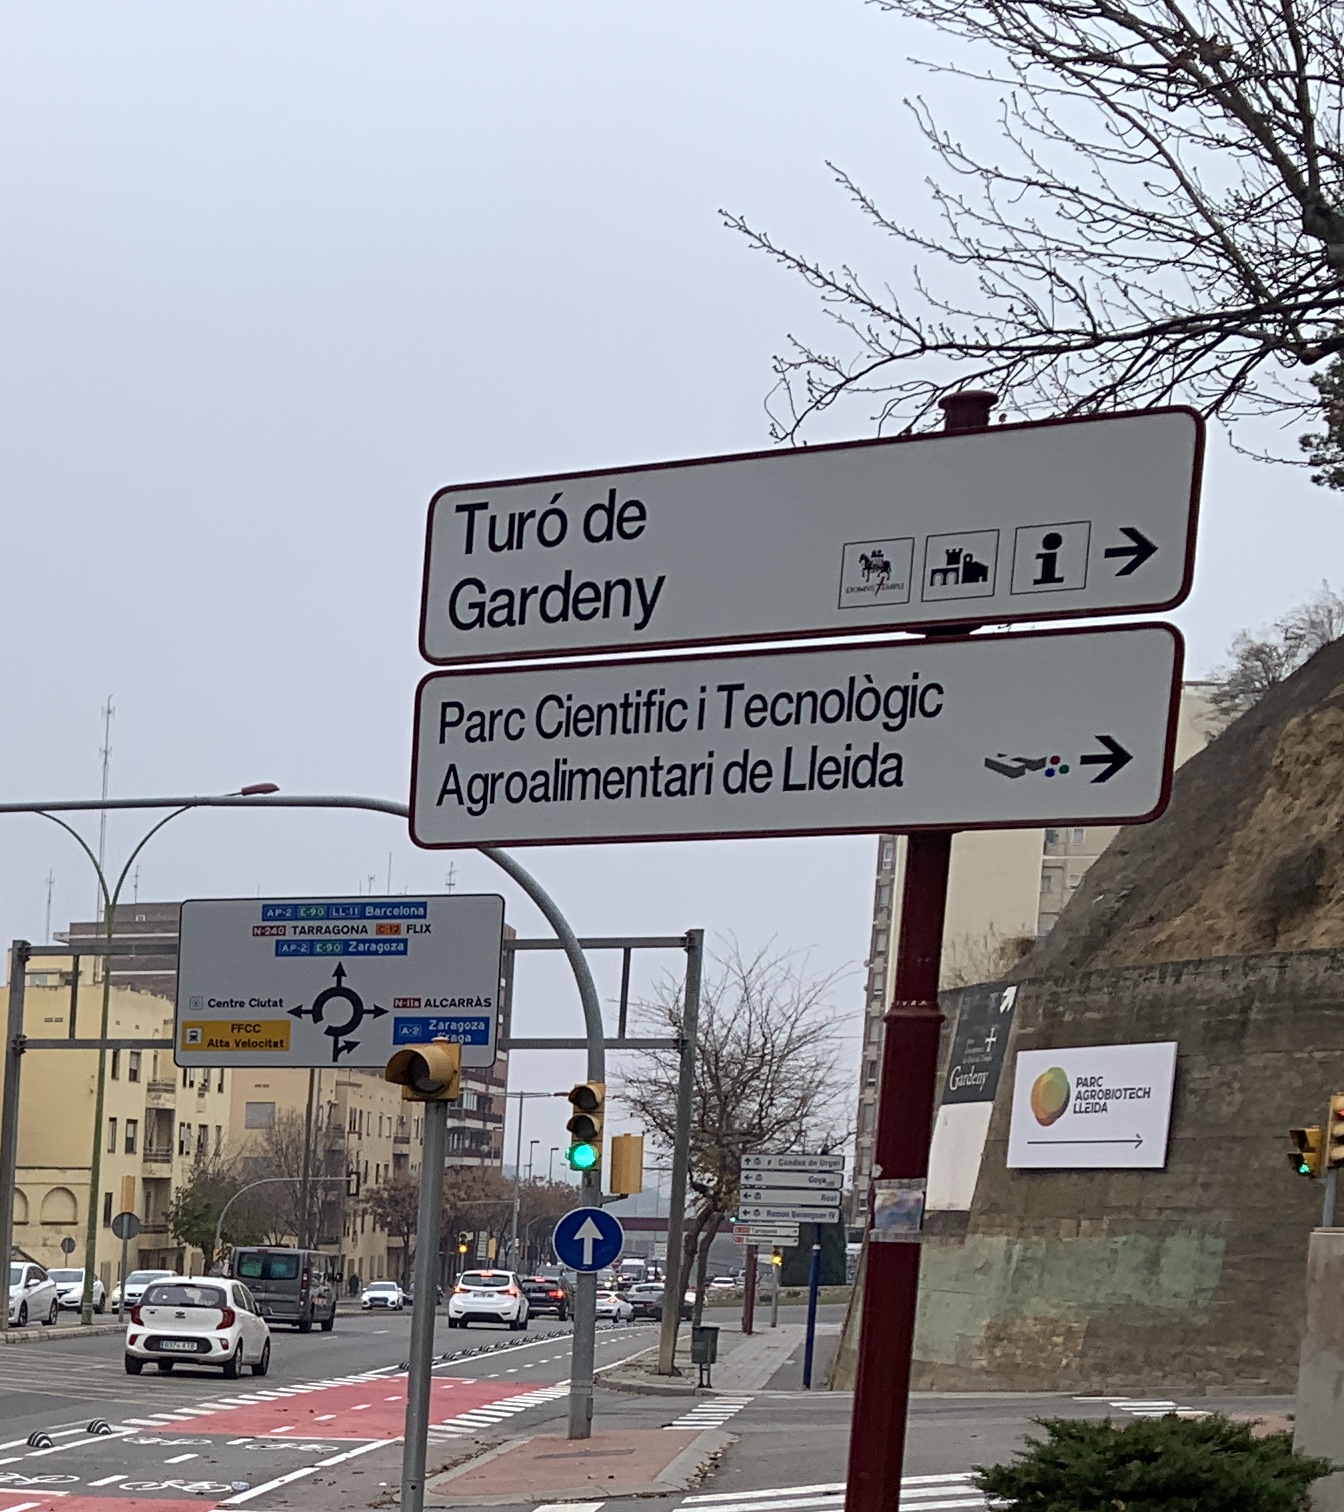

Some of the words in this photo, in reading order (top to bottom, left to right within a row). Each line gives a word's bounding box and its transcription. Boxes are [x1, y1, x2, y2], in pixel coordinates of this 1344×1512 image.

[455, 492, 568, 555] Turó
[583, 488, 647, 544] de
[448, 569, 666, 631] Gardeny
[439, 701, 526, 744] Parc
[697, 685, 707, 731] i
[716, 671, 945, 733] Tecnològic
[436, 750, 714, 817] Agroalimentari
[723, 748, 773, 795] de
[782, 741, 904, 792] Lleida
[266, 908, 292, 917] AP-2
[299, 906, 325, 917] E-90
[365, 905, 424, 917] Barcelona
[253, 926, 285, 935] N-240
[291, 925, 368, 935] TARRAGONA
[406, 923, 432, 934] FLIX
[281, 943, 308, 953] AP-2
[315, 943, 341, 953] E-90
[348, 941, 404, 954] Zaragoza
[207, 998, 245, 1008] Centre
[248, 998, 284, 1008] Ciutat
[424, 995, 492, 1008] ALCARRÀS
[230, 1023, 262, 1034] FFCC
[401, 1026, 420, 1035] A-2
[428, 1020, 485, 1032] Zaragoza
[206, 1039, 230, 1048] Alta
[235, 1039, 284, 1048] Velocitat
[949, 1064, 989, 1092] Gardeny
[1075, 1076, 1104, 1089] PARC
[1074, 1086, 1151, 1101] AGROBIOTECH
[1073, 1101, 1109, 1115] LLEIDA
